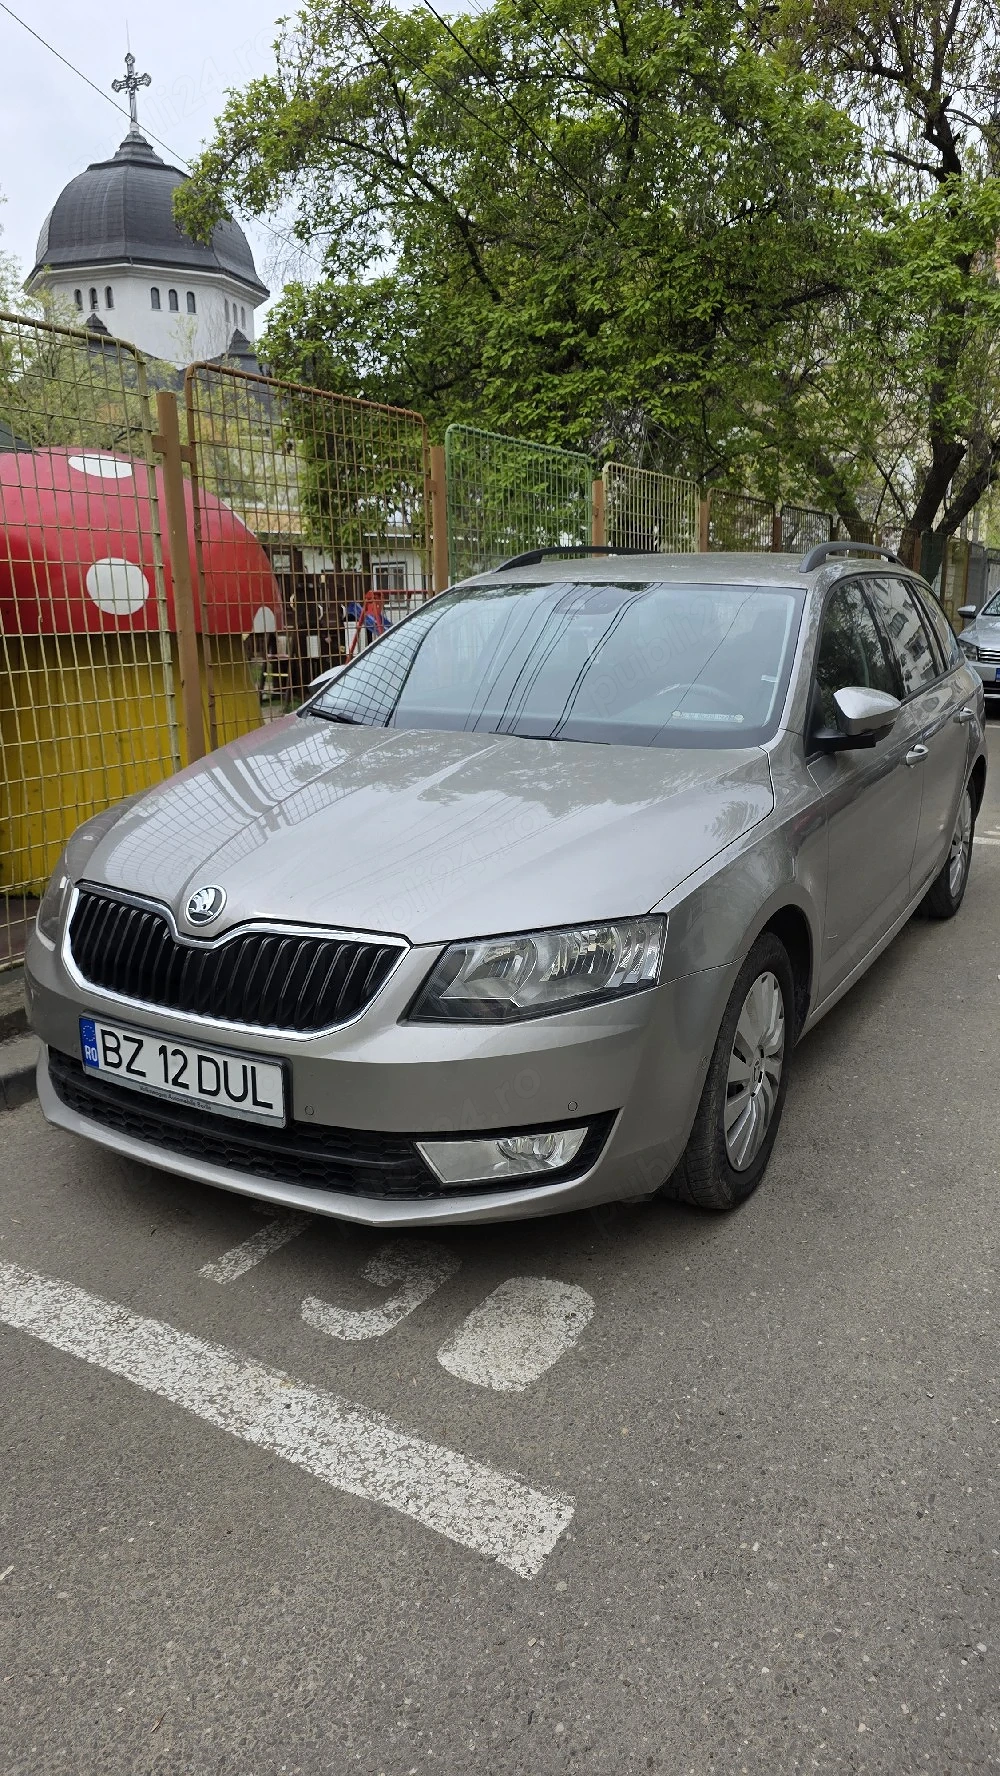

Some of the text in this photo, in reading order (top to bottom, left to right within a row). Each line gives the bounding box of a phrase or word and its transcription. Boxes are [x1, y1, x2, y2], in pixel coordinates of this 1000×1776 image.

[84, 1045, 98, 1062] RO
[101, 1028, 273, 1110] BZ 12 DUL
